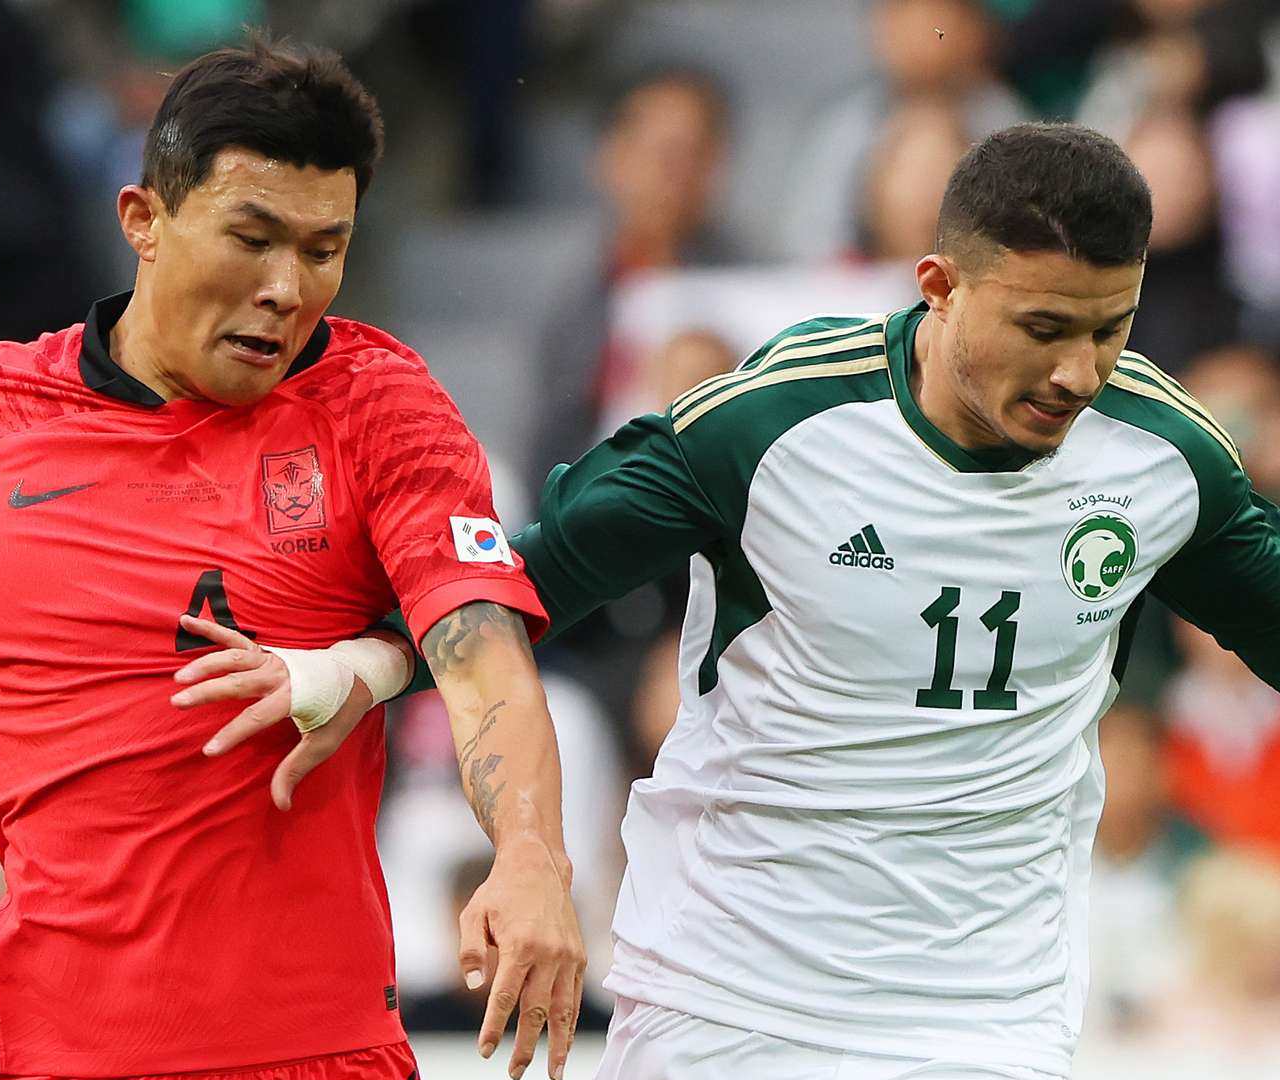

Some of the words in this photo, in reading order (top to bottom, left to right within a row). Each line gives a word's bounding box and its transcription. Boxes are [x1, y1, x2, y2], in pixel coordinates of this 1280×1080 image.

[1067, 493, 1133, 511] السعودية
[271, 536, 330, 554] KOREA
[829, 550, 894, 570] adidas
[1101, 565, 1124, 575] SAFF
[175, 568, 257, 652] 4
[1076, 608, 1114, 625] SAUDI
[915, 586, 1021, 711] 11
